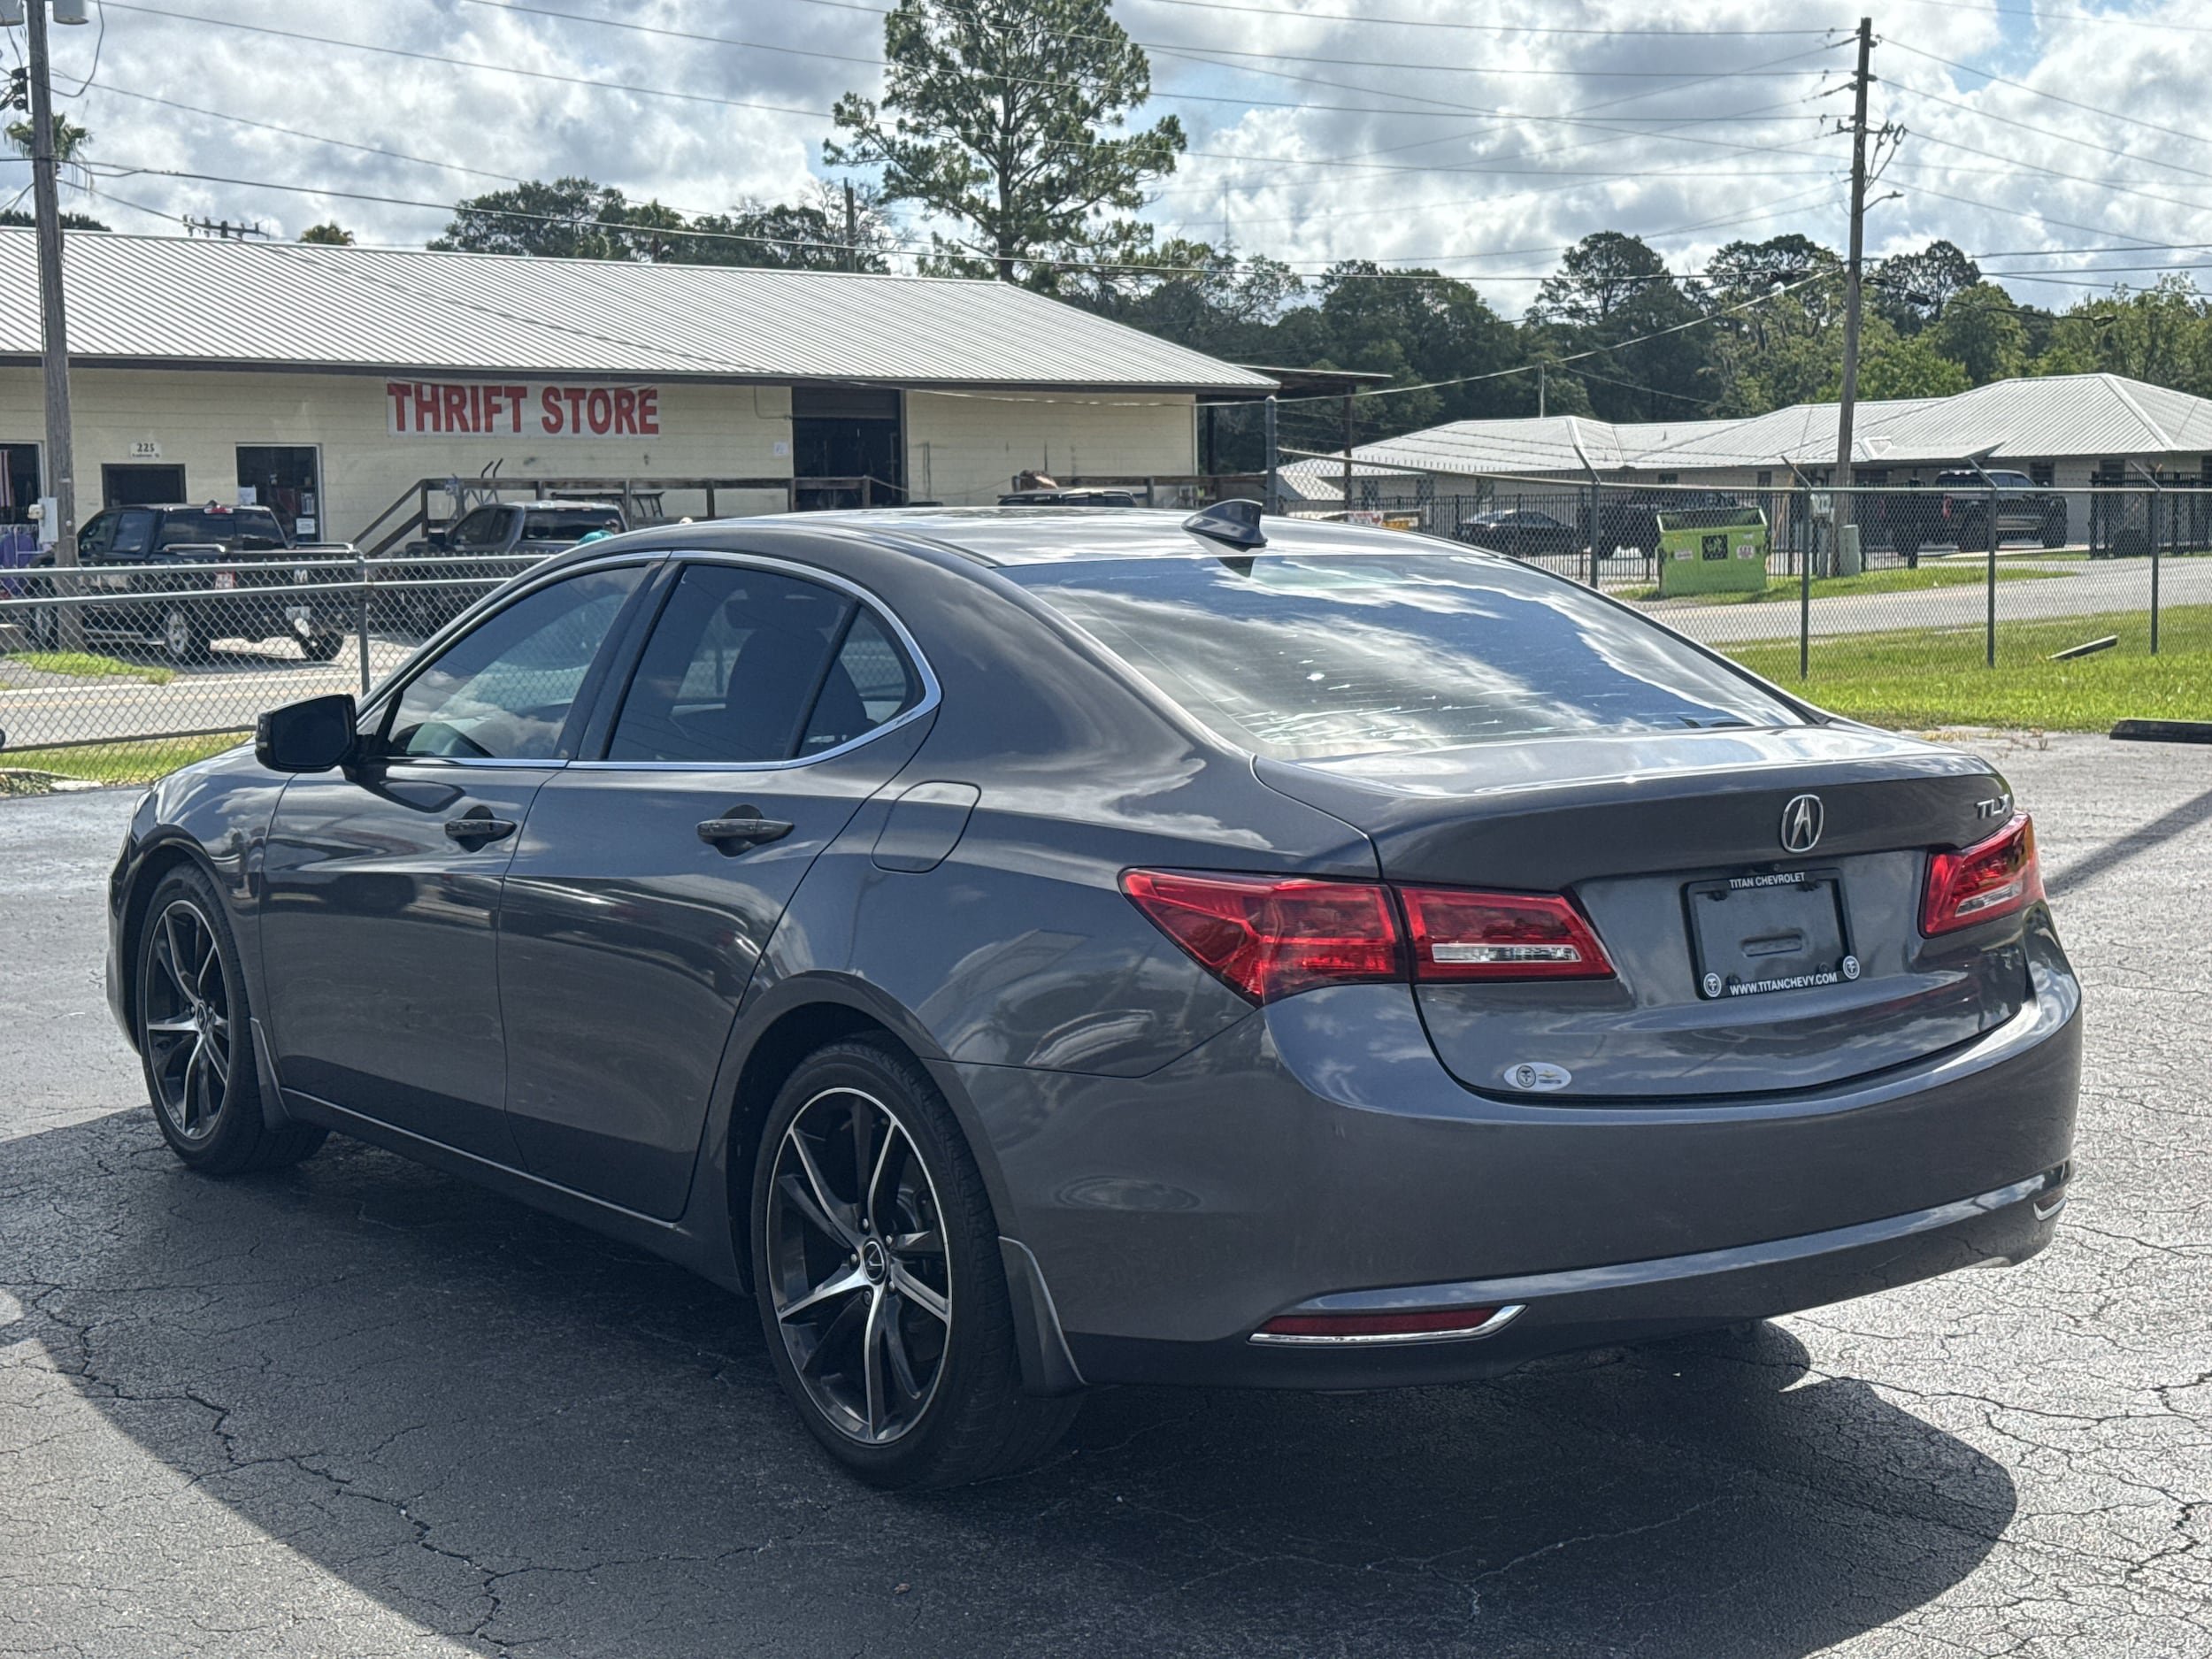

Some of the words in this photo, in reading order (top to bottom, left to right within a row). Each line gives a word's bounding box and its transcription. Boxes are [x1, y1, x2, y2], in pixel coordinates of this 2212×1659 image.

[387, 382, 527, 433] THRIFT
[541, 386, 659, 434] STORE
[137, 442, 155, 452] 225
[1977, 794, 2009, 819] TLX
[1729, 878, 1755, 889] TITAN
[1755, 872, 1806, 887] CHEVROLET
[1729, 972, 1838, 996] WWW.TITANCHEVY.COM
